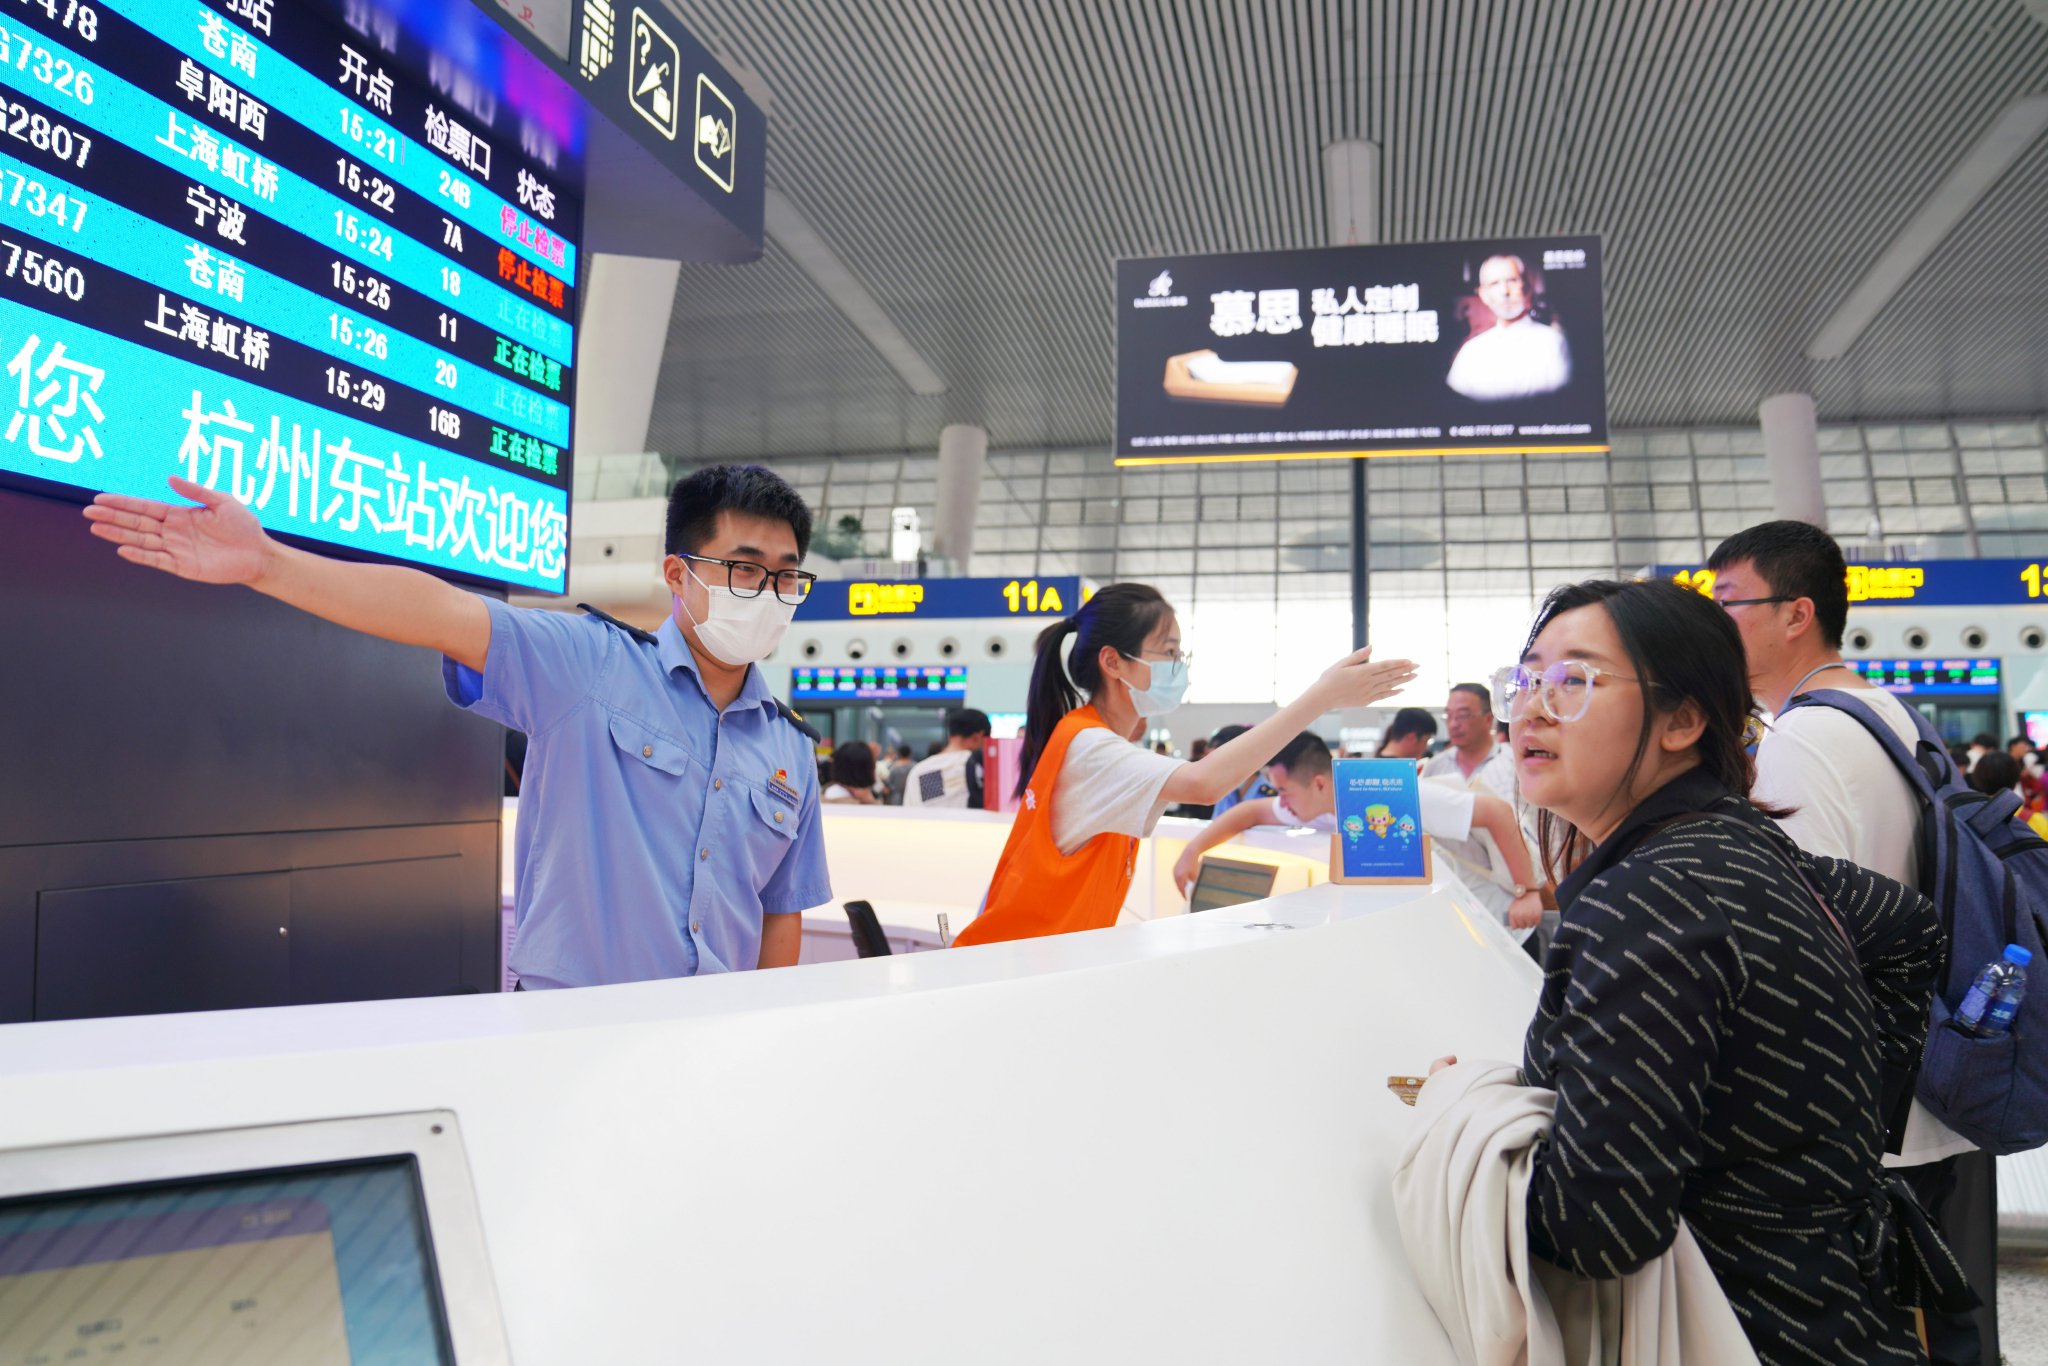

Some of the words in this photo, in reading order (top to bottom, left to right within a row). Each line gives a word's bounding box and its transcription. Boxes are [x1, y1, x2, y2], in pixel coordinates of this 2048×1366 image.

[20, 0, 98, 42] 478
[198, 10, 258, 79] 苍南
[339, 107, 395, 163] 15:21
[438, 170, 471, 209] 24B
[500, 204, 566, 268] 停止检票
[155, 110, 279, 201] 上海虹桥
[334, 209, 394, 262] 15:24
[440, 266, 461, 297] 18
[175, 57, 268, 141] 阜阳西
[336, 158, 396, 214] 15:22
[441, 217, 464, 253] 7A
[497, 246, 565, 309] 停止检票
[338, 43, 394, 116] 开点
[424, 104, 491, 181] 检票口
[516, 167, 555, 220] 状态
[0, 167, 88, 233] 7347
[185, 184, 247, 246] 宁波
[331, 260, 391, 311] 15:25
[438, 312, 457, 343] 11
[493, 336, 562, 392] 正在检票
[184, 242, 246, 303] 苍南
[329, 312, 388, 361] 15:26
[435, 358, 458, 389] 20
[5, 333, 105, 464] 您
[144, 293, 271, 371] 上海虹桥
[325, 366, 386, 412] 15:29
[428, 405, 461, 440] 16B
[488, 425, 559, 476] 正在检票
[1002, 580, 1063, 613] 11A
